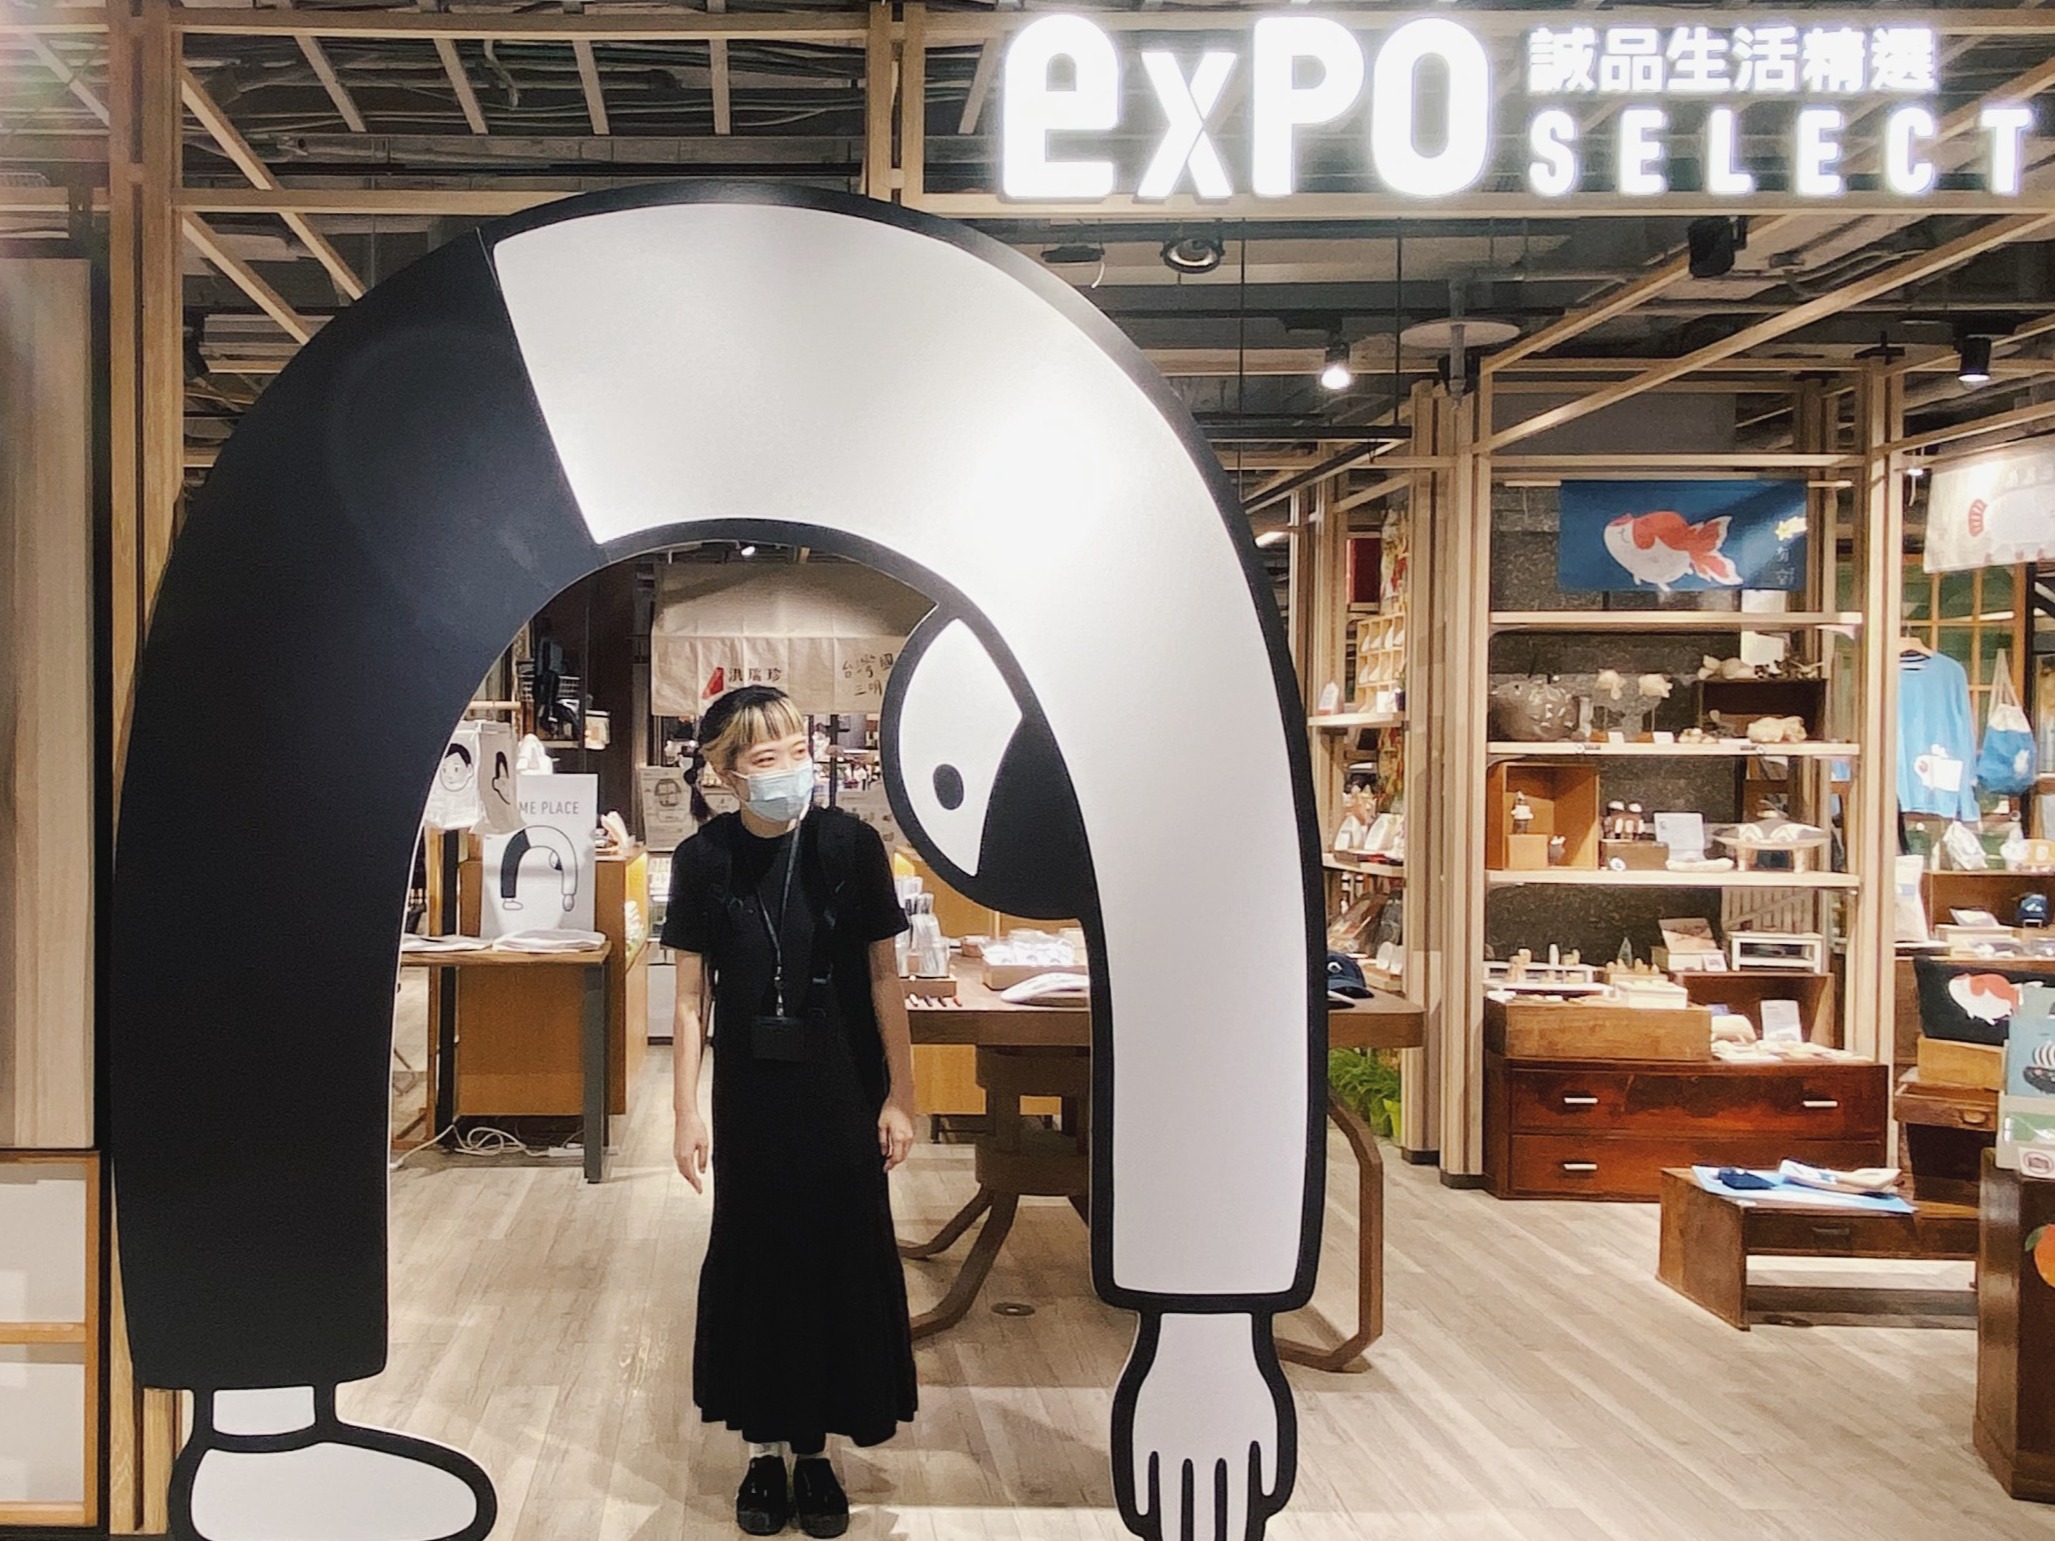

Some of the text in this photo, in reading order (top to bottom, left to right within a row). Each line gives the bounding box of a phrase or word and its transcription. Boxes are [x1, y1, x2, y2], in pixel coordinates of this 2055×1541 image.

[1528, 26, 1936, 93] 誠品生活精選
[1528, 107, 2034, 196] SELECT
[728, 667, 782, 682] 洪瑞珍
[541, 801, 579, 815] PLACE
